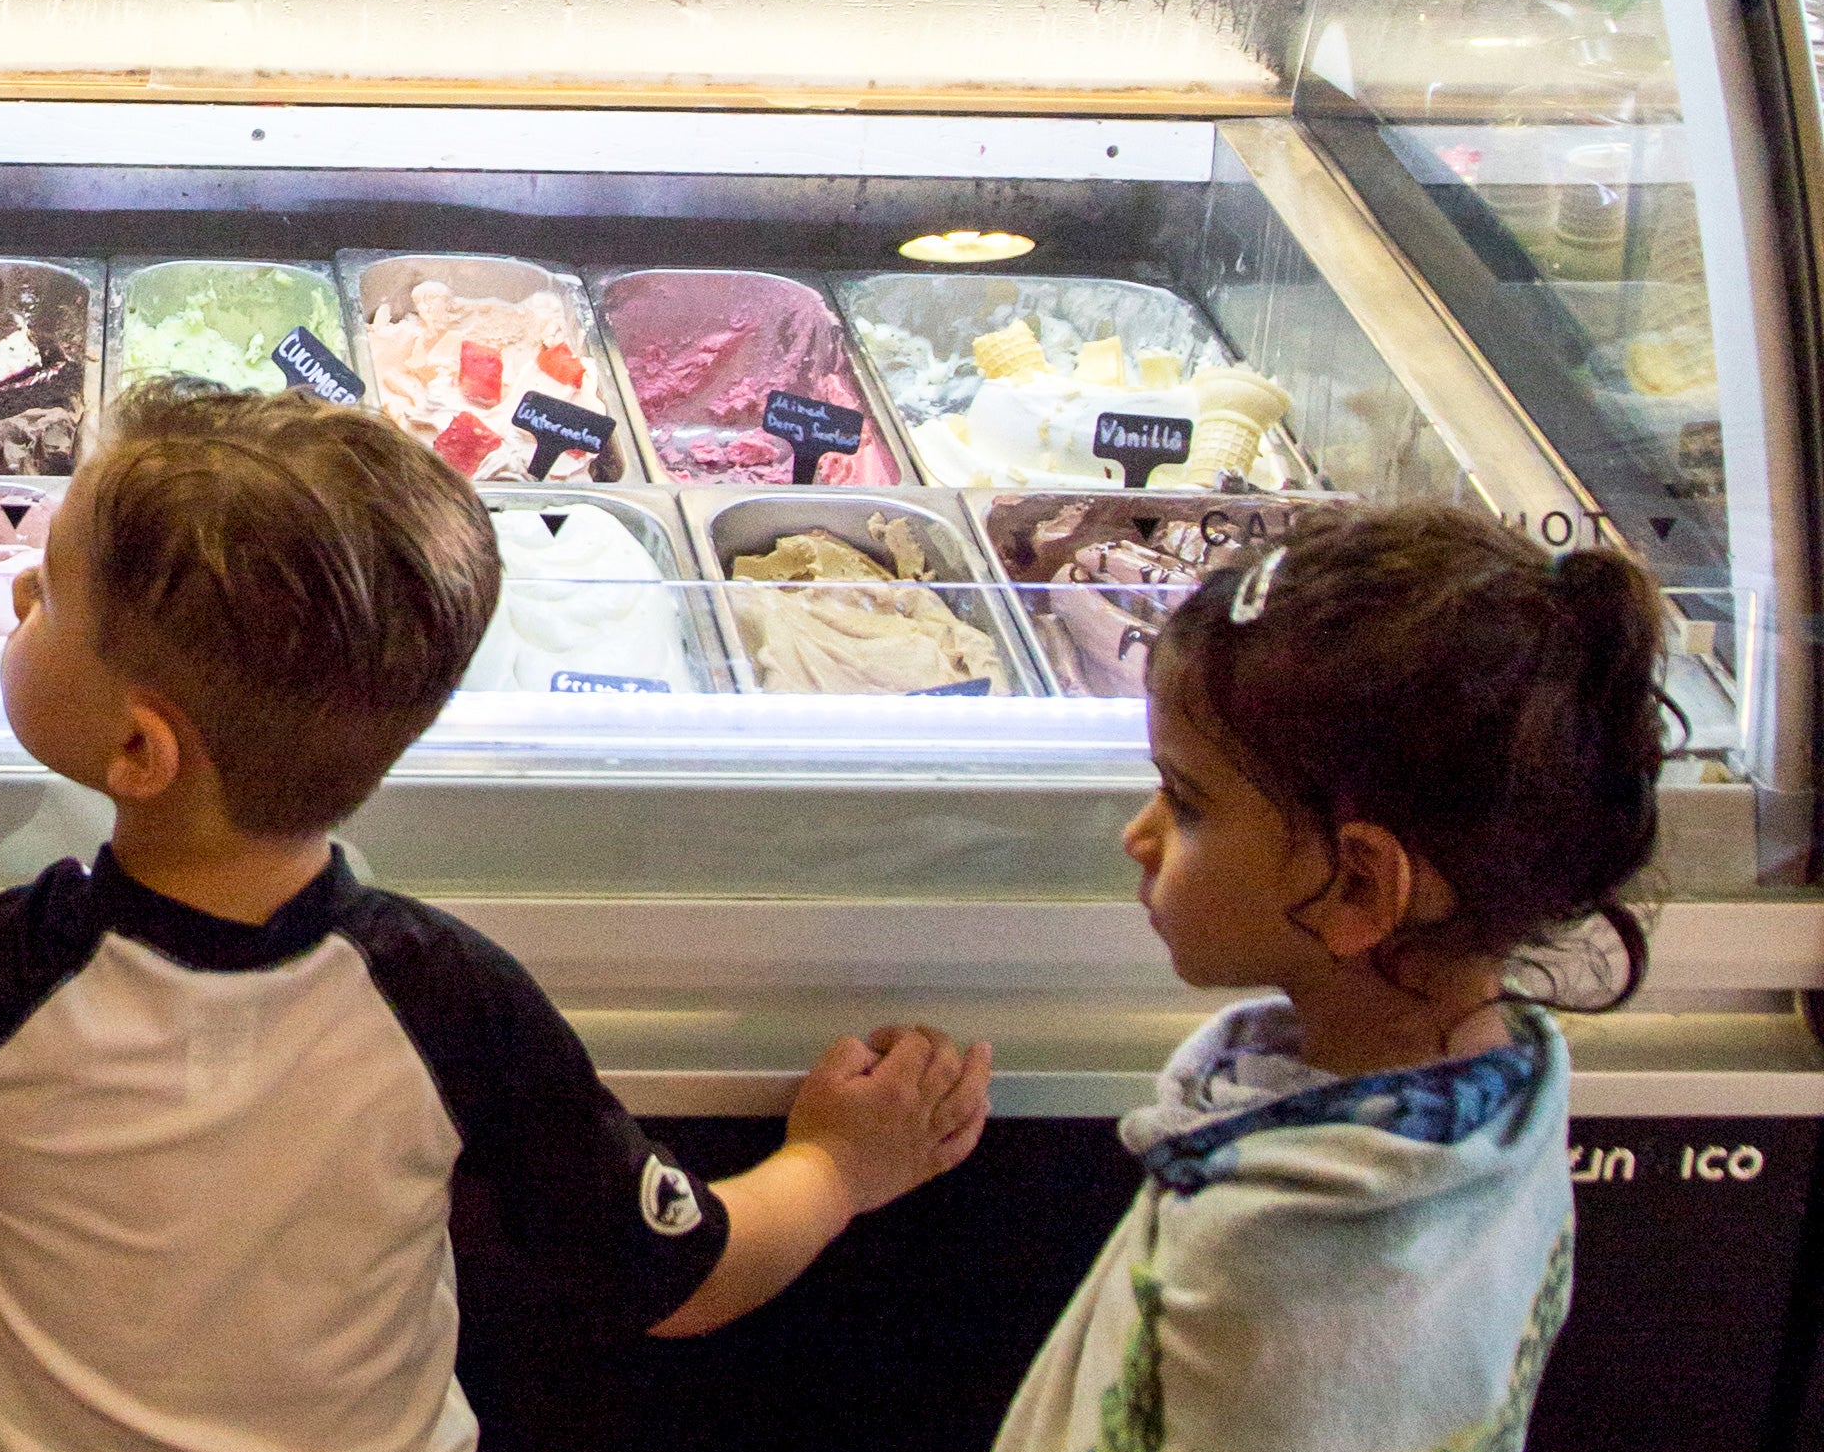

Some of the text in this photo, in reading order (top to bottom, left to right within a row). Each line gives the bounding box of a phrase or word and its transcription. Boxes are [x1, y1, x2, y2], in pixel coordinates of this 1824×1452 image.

[517, 402, 602, 451] Watermelon
[1100, 418, 1185, 451] Vanilla
[1680, 1145, 1765, 1182] ICO
